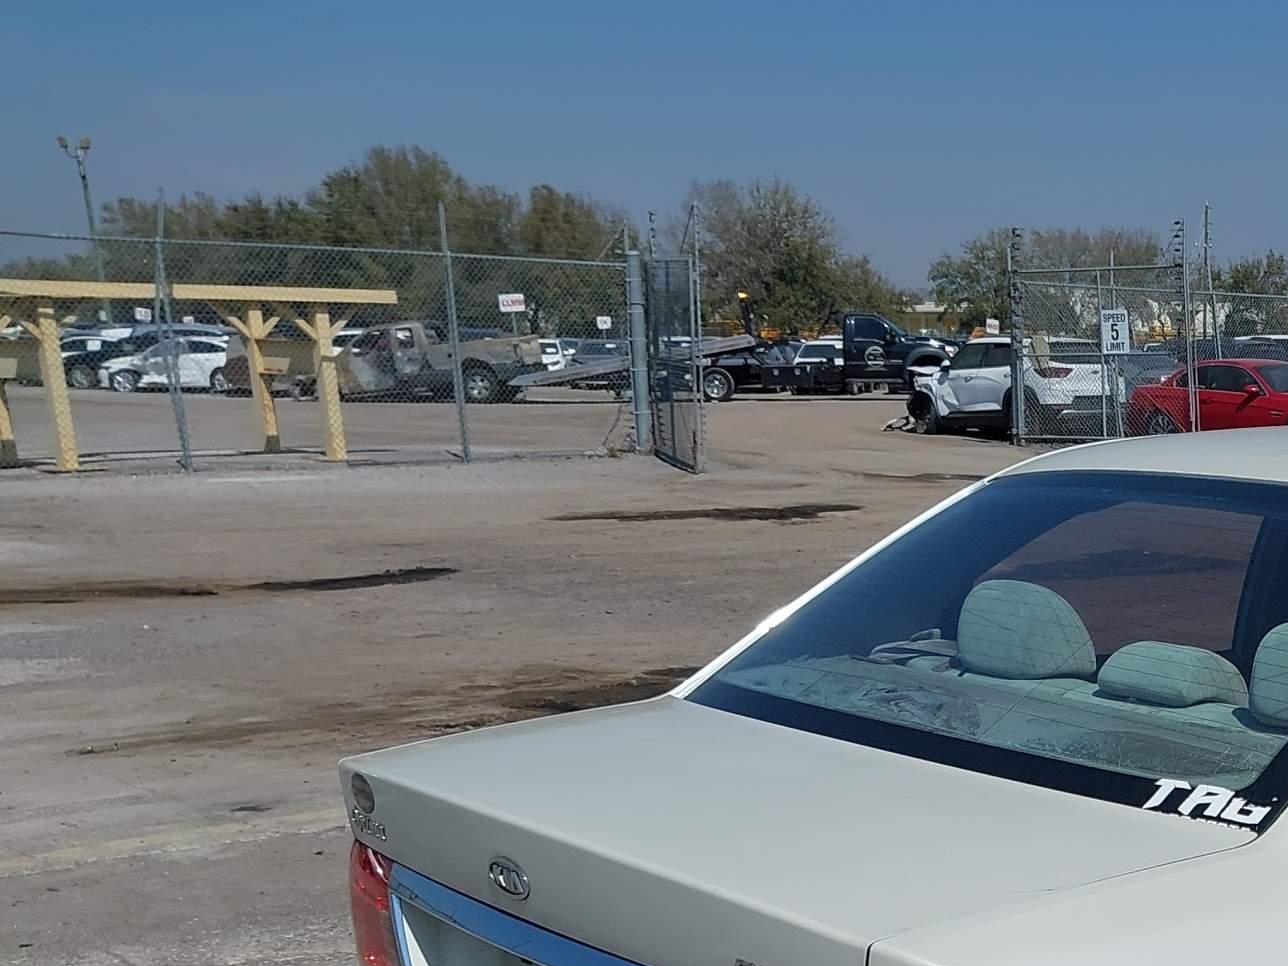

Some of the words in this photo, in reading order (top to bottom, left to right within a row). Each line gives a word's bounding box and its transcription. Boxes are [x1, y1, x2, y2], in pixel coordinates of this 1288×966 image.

[1103, 313, 1126, 323] SPEED
[1111, 323, 1119, 341] 5
[1105, 342, 1125, 351] LIMIT
